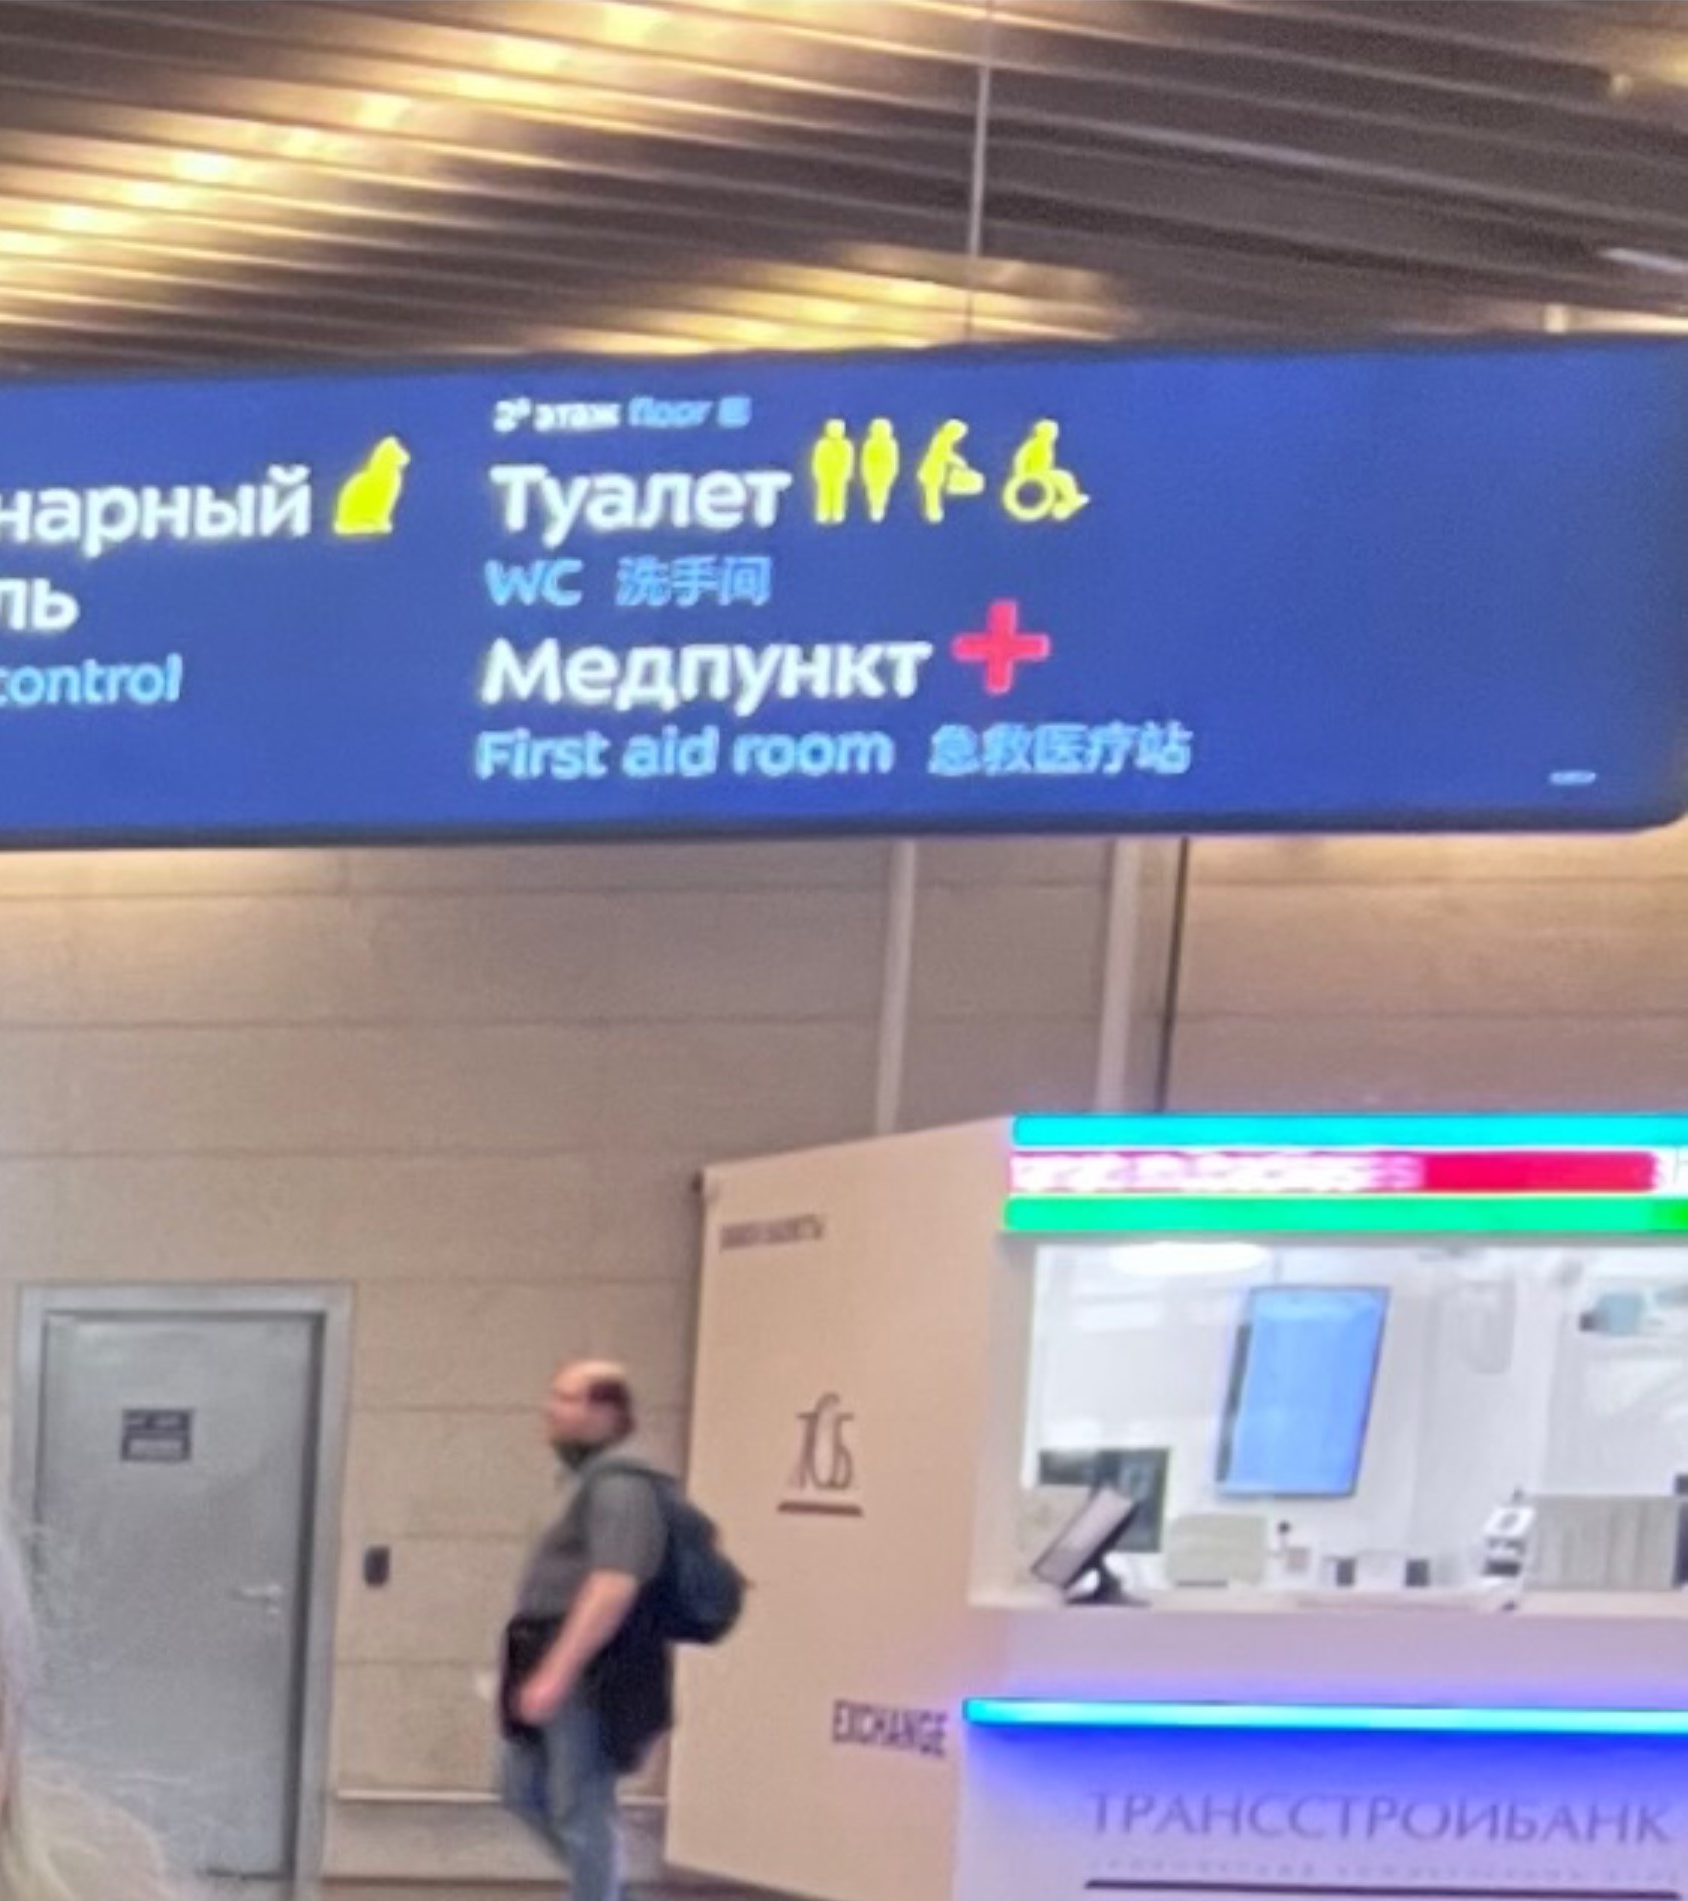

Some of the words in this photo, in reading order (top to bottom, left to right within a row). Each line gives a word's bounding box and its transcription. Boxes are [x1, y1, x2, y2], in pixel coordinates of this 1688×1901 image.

[629, 397, 713, 427] floor
[490, 463, 793, 548] Туалет
[485, 559, 583, 608] WC
[614, 556, 772, 606] 洗手间
[480, 635, 934, 718] Медпункт
[476, 728, 609, 780] First
[621, 724, 719, 776] aid
[734, 737, 895, 774] room
[928, 721, 1194, 777] 急救医疗站
[833, 1700, 948, 1757] EXCHANGE
